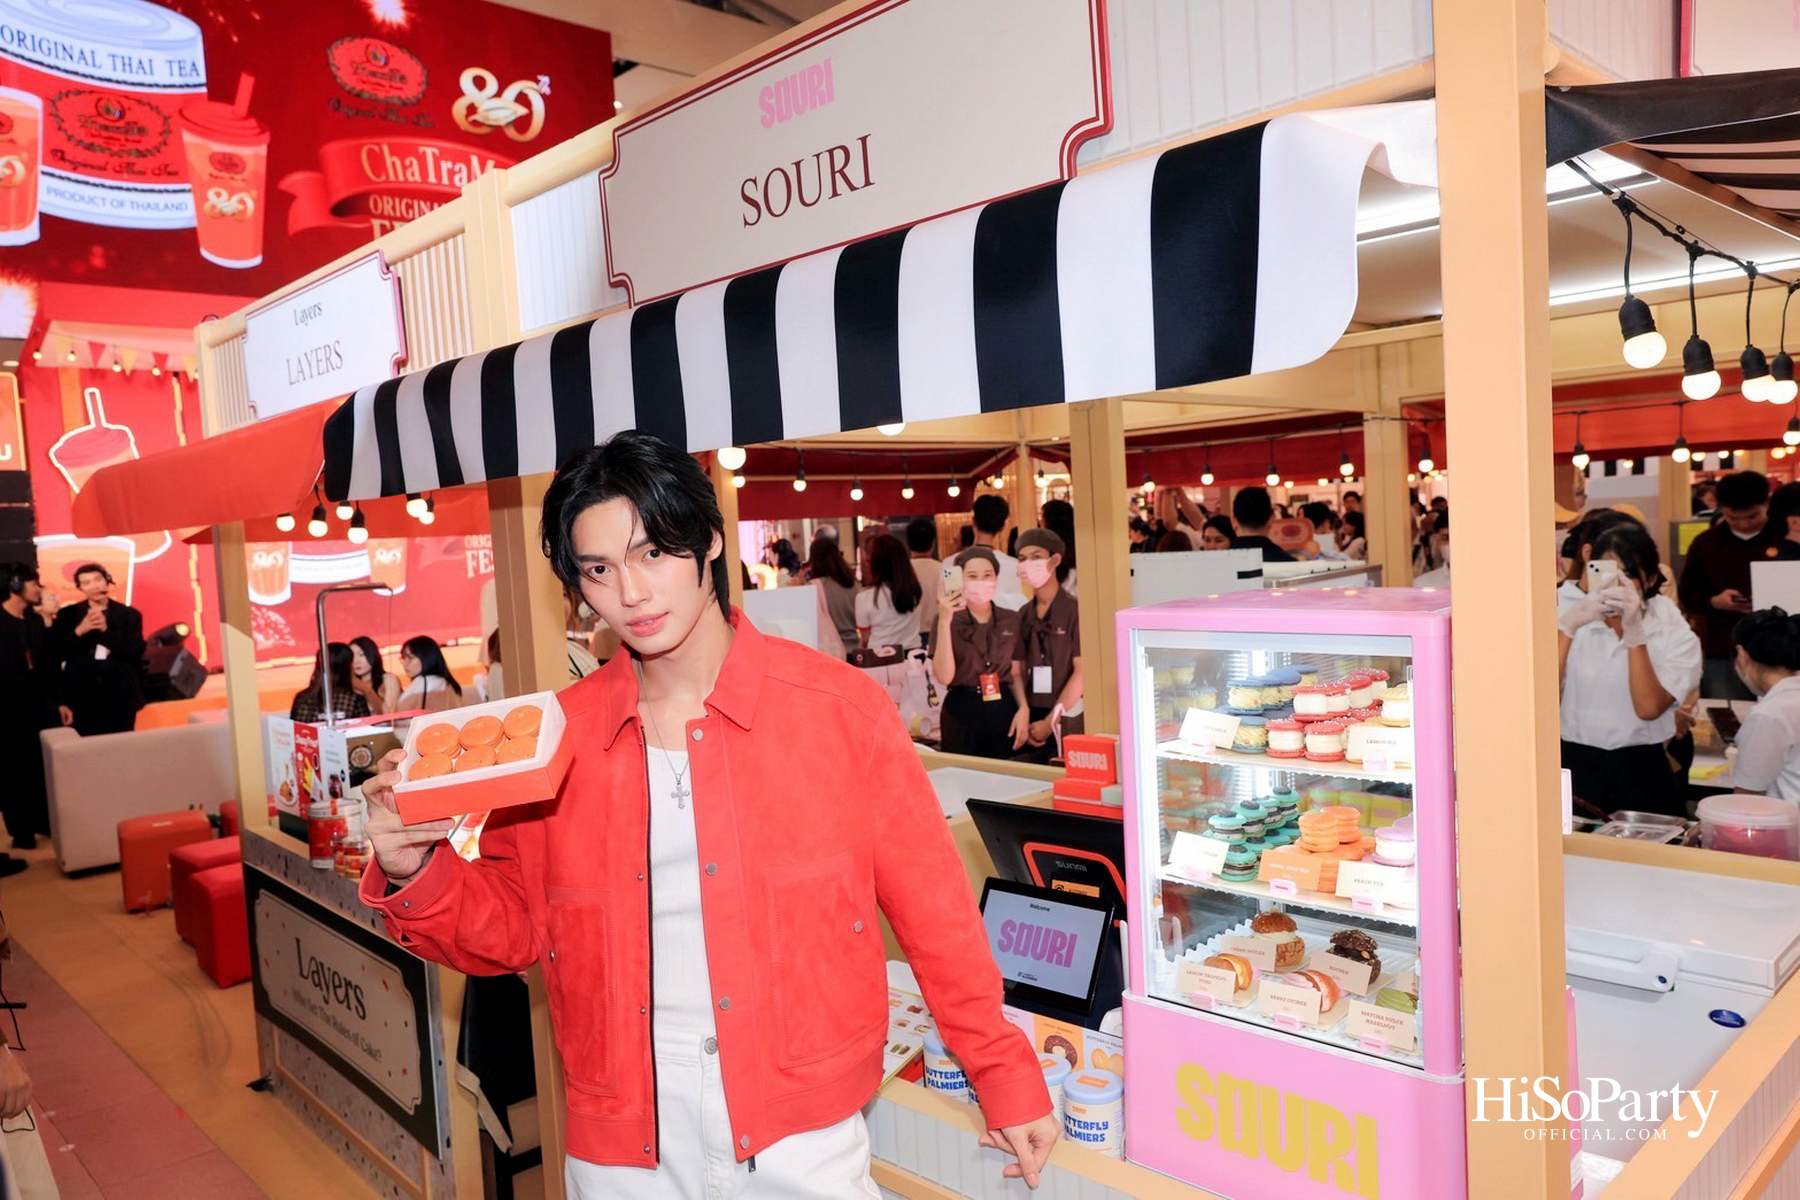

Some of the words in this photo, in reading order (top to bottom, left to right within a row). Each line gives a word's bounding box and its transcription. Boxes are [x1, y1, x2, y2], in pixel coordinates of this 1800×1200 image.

[0, 24, 102, 69] ORIGINAL
[107, 53, 154, 76] THAI
[166, 60, 200, 78] TEA
[760, 58, 834, 129] SOURI
[46, 186, 107, 208] PRODUCT
[110, 199, 125, 209] OF
[130, 200, 188, 212] THAILAND
[740, 134, 875, 228] SOURI
[293, 302, 323, 326] Layers
[286, 340, 344, 386] LAYERS
[1068, 750, 1108, 771] SOURI
[1030, 903, 1051, 912] Welcome
[997, 919, 1078, 968] SOURI
[295, 937, 367, 1020] Layers
[1186, 969, 1204, 977] LEMON
[1270, 994, 1287, 1003] BERRY
[1287, 997, 1308, 1007] LYCHEE
[1361, 1010, 1384, 1020] MATCHA
[1175, 1062, 1380, 1200] SOURI
